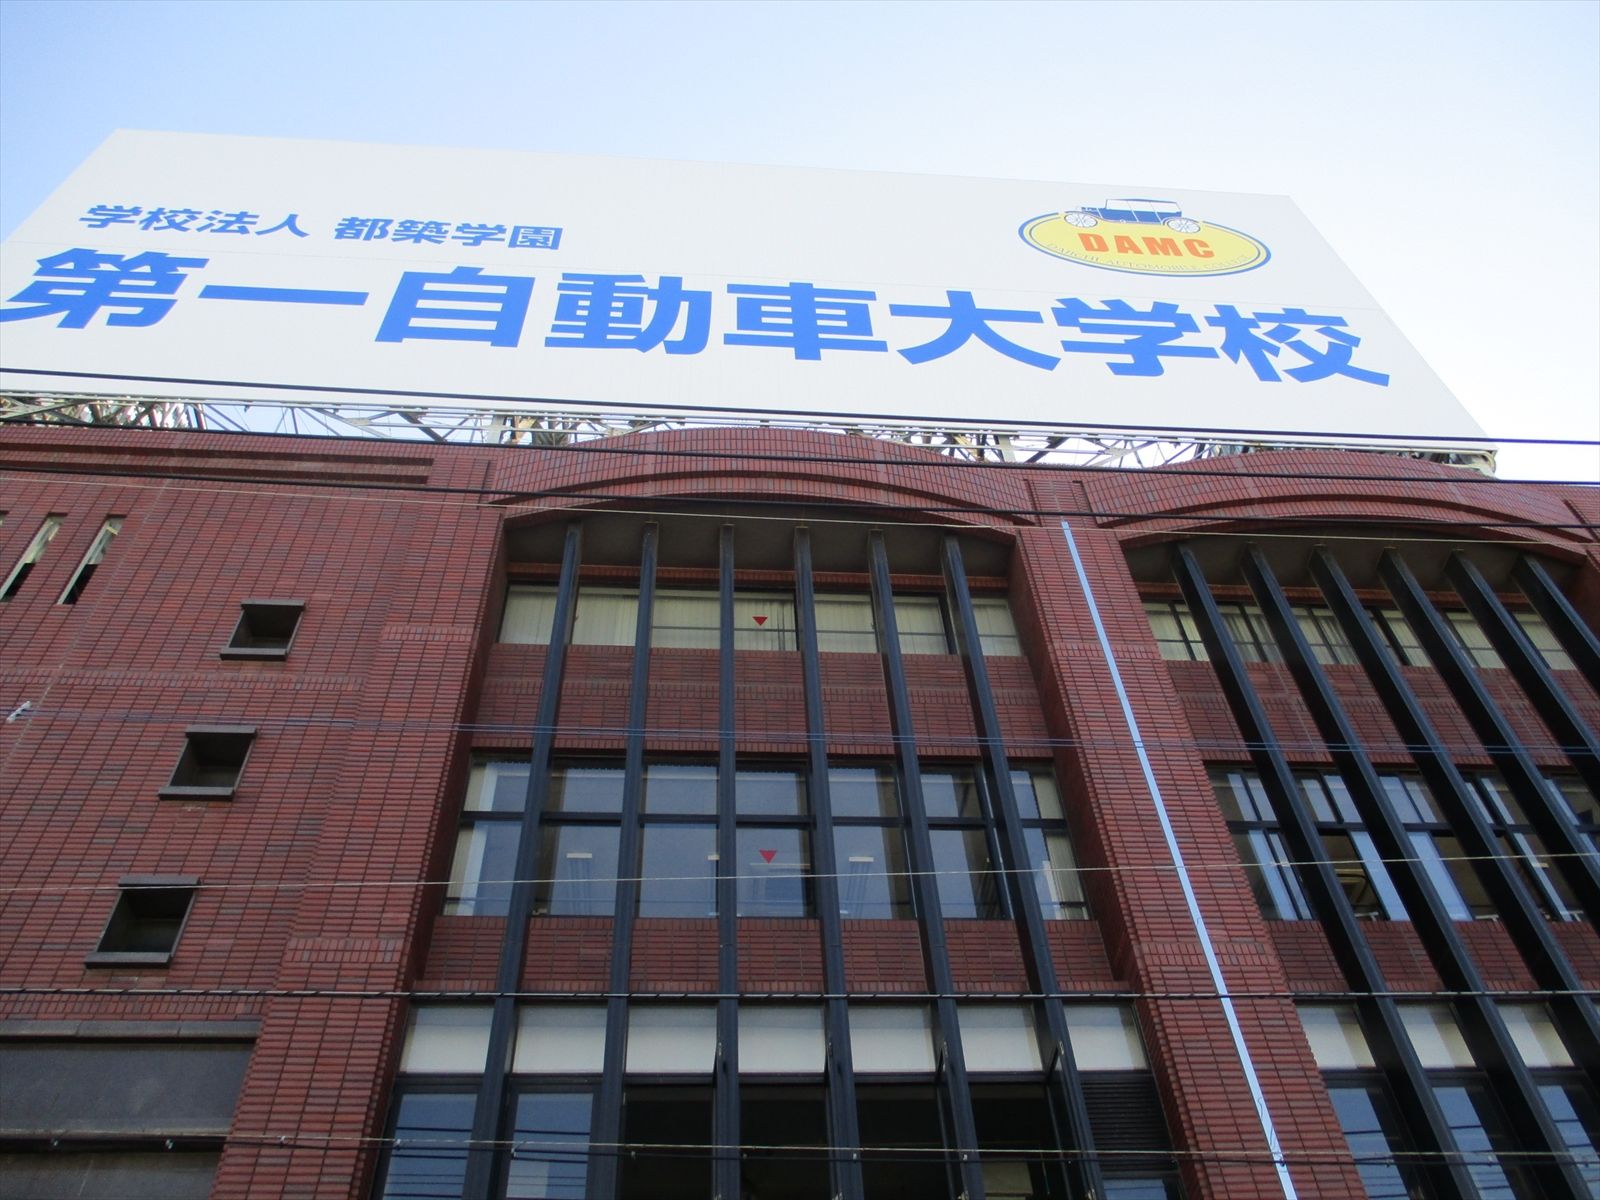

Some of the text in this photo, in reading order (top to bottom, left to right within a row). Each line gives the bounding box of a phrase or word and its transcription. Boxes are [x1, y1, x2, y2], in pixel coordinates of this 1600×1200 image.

[79, 204, 563, 250] 学校法人 都築学園
[1079, 233, 1215, 258] DAMC
[0, 248, 1389, 385] 第一自動車大学校
